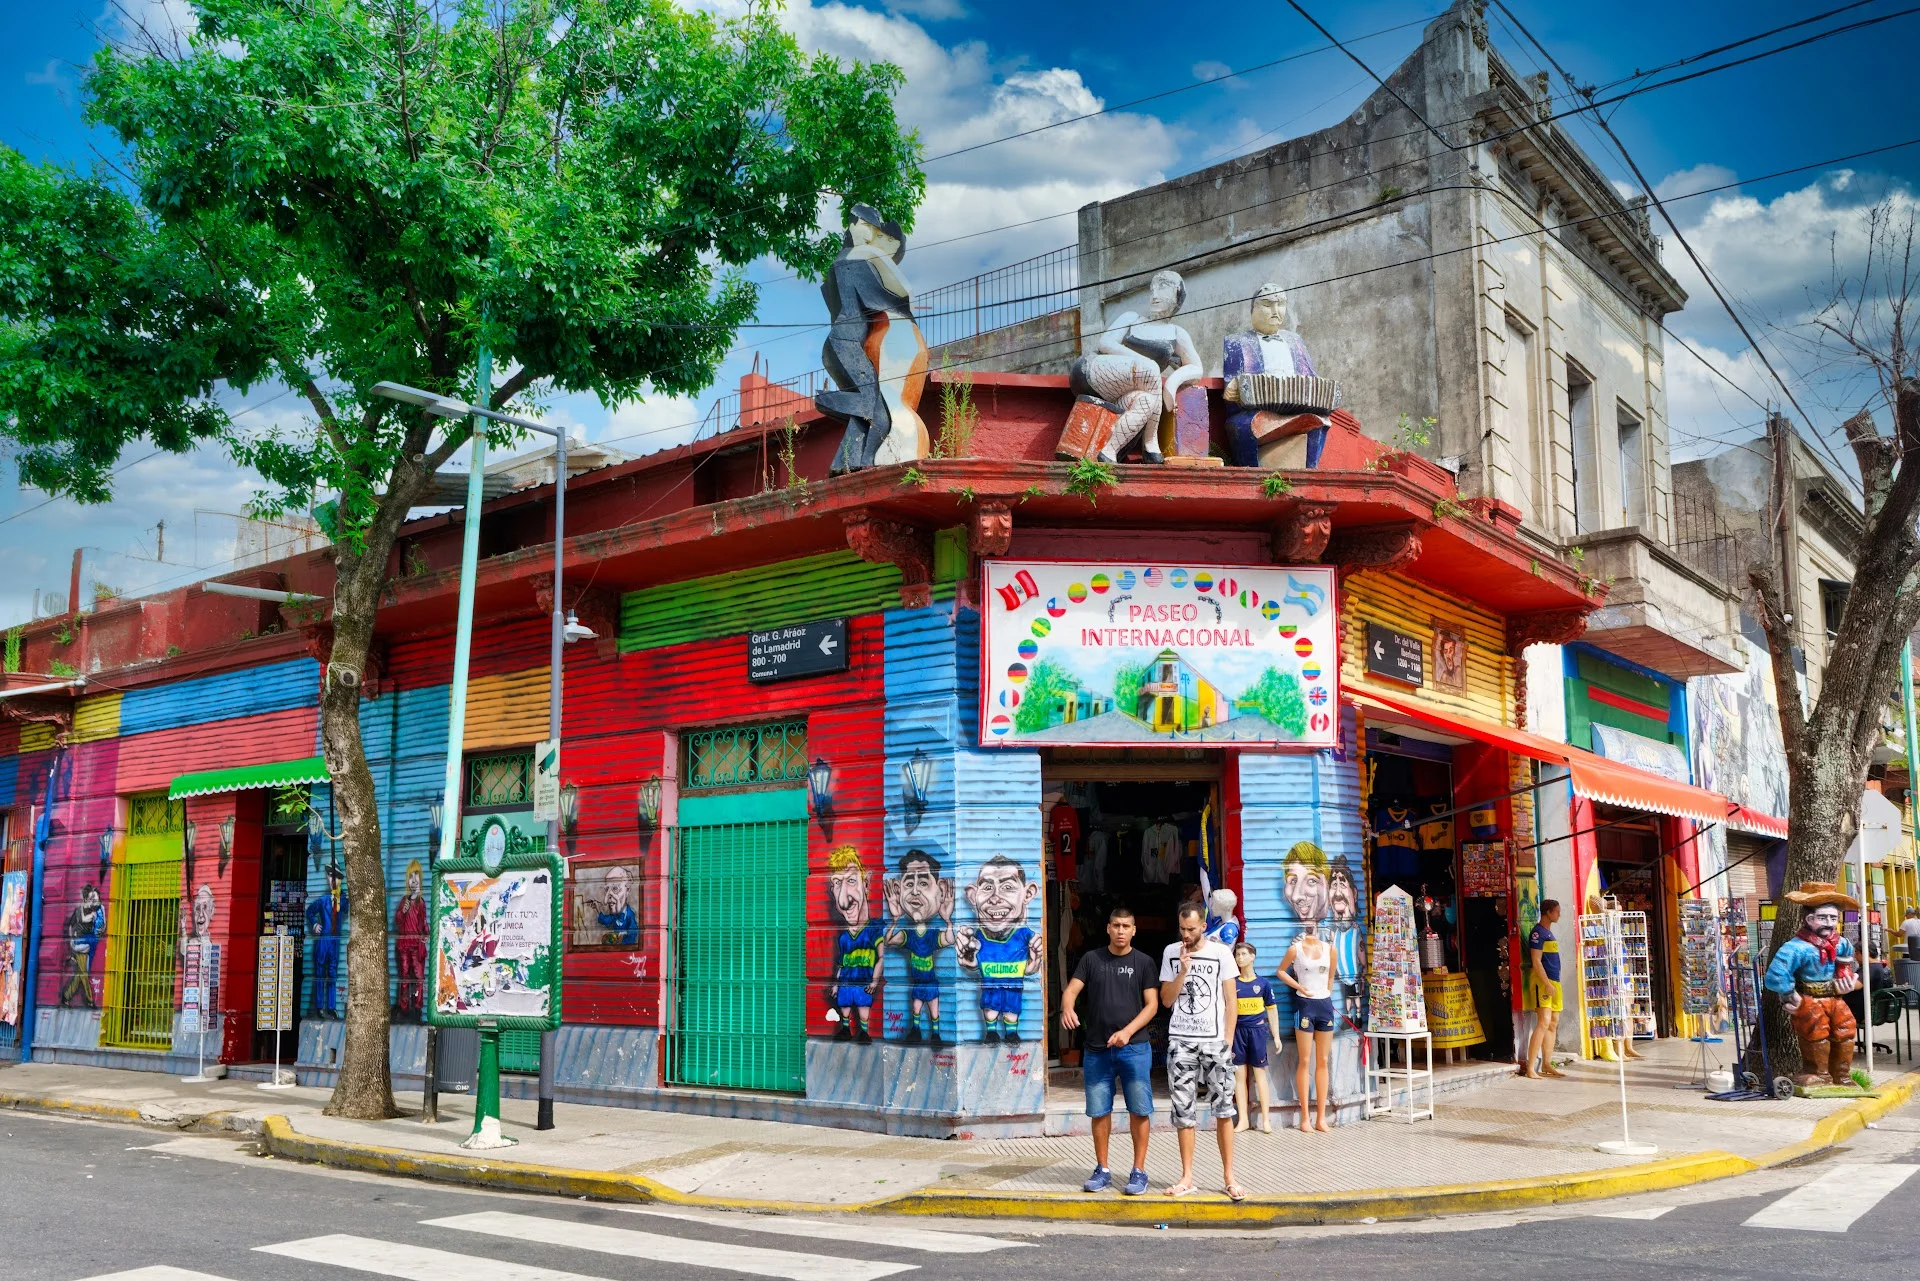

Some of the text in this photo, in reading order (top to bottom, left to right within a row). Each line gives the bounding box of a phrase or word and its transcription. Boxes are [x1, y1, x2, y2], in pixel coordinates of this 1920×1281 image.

[1129, 604, 1198, 622] PASEO
[752, 627, 807, 644] Gral. G. Aráoz
[1081, 628, 1255, 647] INTERNACIONAL
[752, 639, 801, 655] de Lamadrid
[752, 657, 766, 667] 800
[773, 653, 787, 664] 700
[752, 670, 773, 678] Comuna
[1062, 833, 1071, 853] 2
[1190, 964, 1213, 975] MAYO
